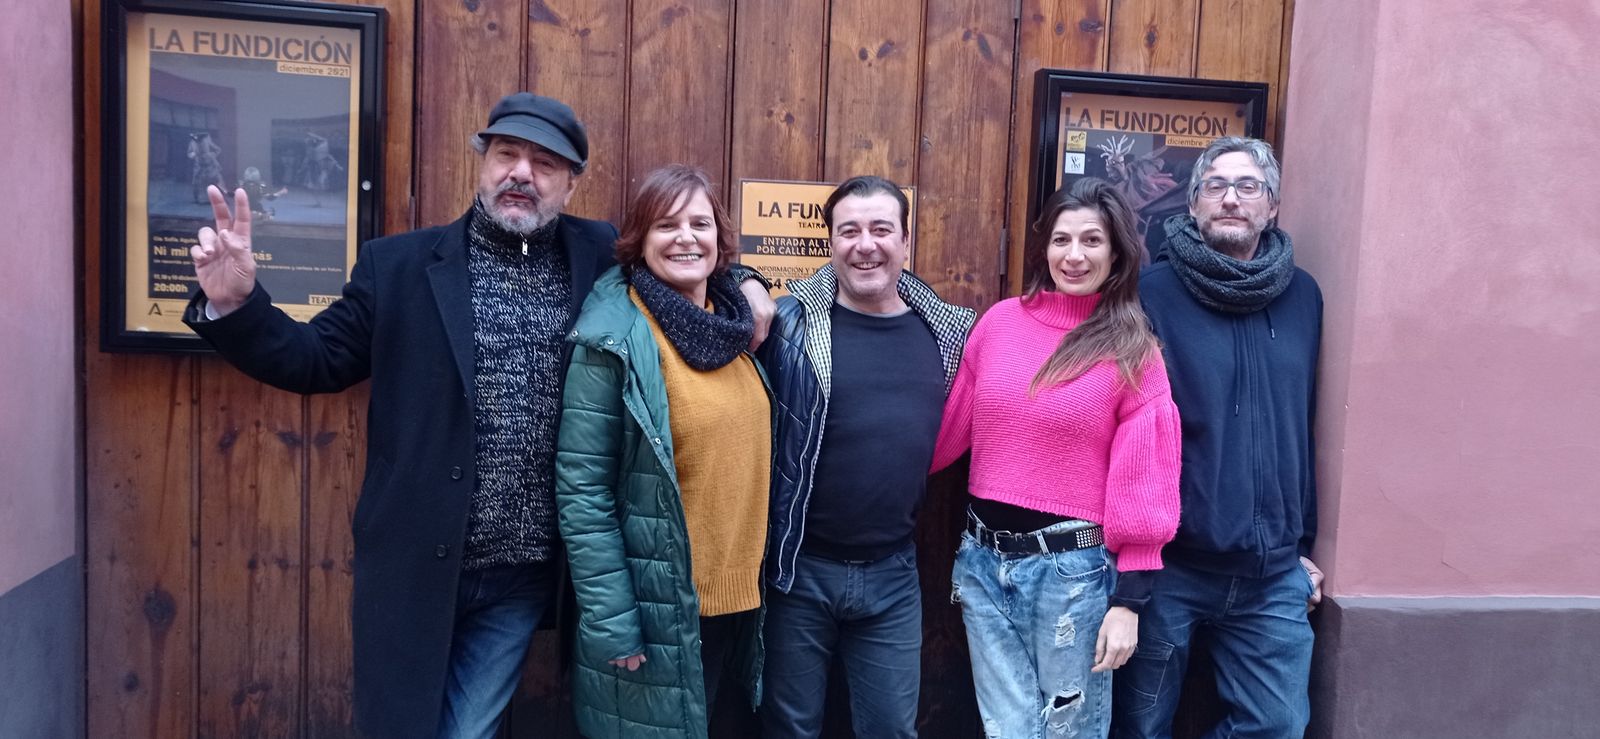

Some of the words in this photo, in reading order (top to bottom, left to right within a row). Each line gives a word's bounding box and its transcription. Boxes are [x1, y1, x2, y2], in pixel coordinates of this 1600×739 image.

[150, 28, 184, 51] LA
[193, 31, 351, 64] FUNDICIÓN
[279, 64, 324, 75] diciembre
[1065, 107, 1093, 128] LA
[1101, 109, 1228, 136] FUNDICIÓN
[1167, 138, 1203, 146] diciembre
[758, 201, 782, 218] LA
[763, 237, 806, 247] ENTRADA
[808, 239, 820, 248] AL
[153, 246, 167, 256] Ni
[170, 247, 188, 256] mil
[756, 245, 776, 255] POR
[778, 246, 807, 256] CALLE
[153, 283, 188, 293] 20:00h
